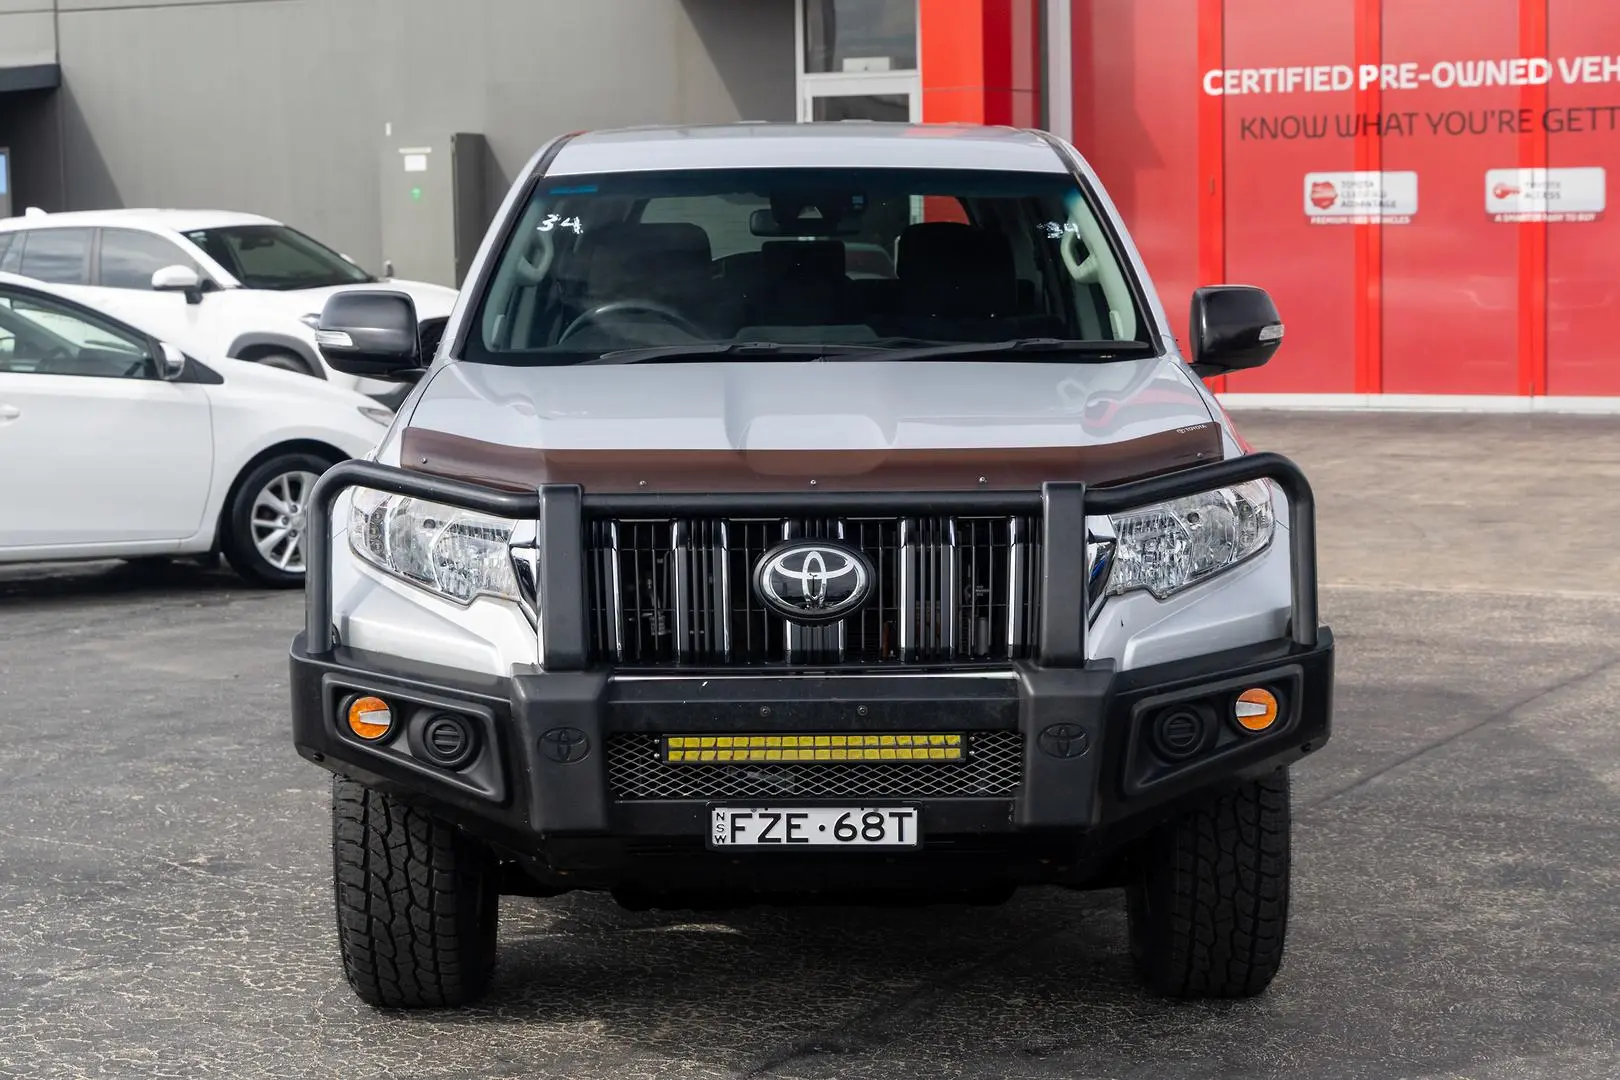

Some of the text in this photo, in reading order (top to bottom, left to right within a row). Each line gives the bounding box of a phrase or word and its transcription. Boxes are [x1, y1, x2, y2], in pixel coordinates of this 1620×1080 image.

[1203, 65, 1353, 96] CERTIFIED
[1359, 57, 1553, 91] PRE-OWNED
[1240, 114, 1328, 140] KNOW
[1335, 112, 1419, 138] WHAT
[1426, 108, 1533, 136] YOU'RE
